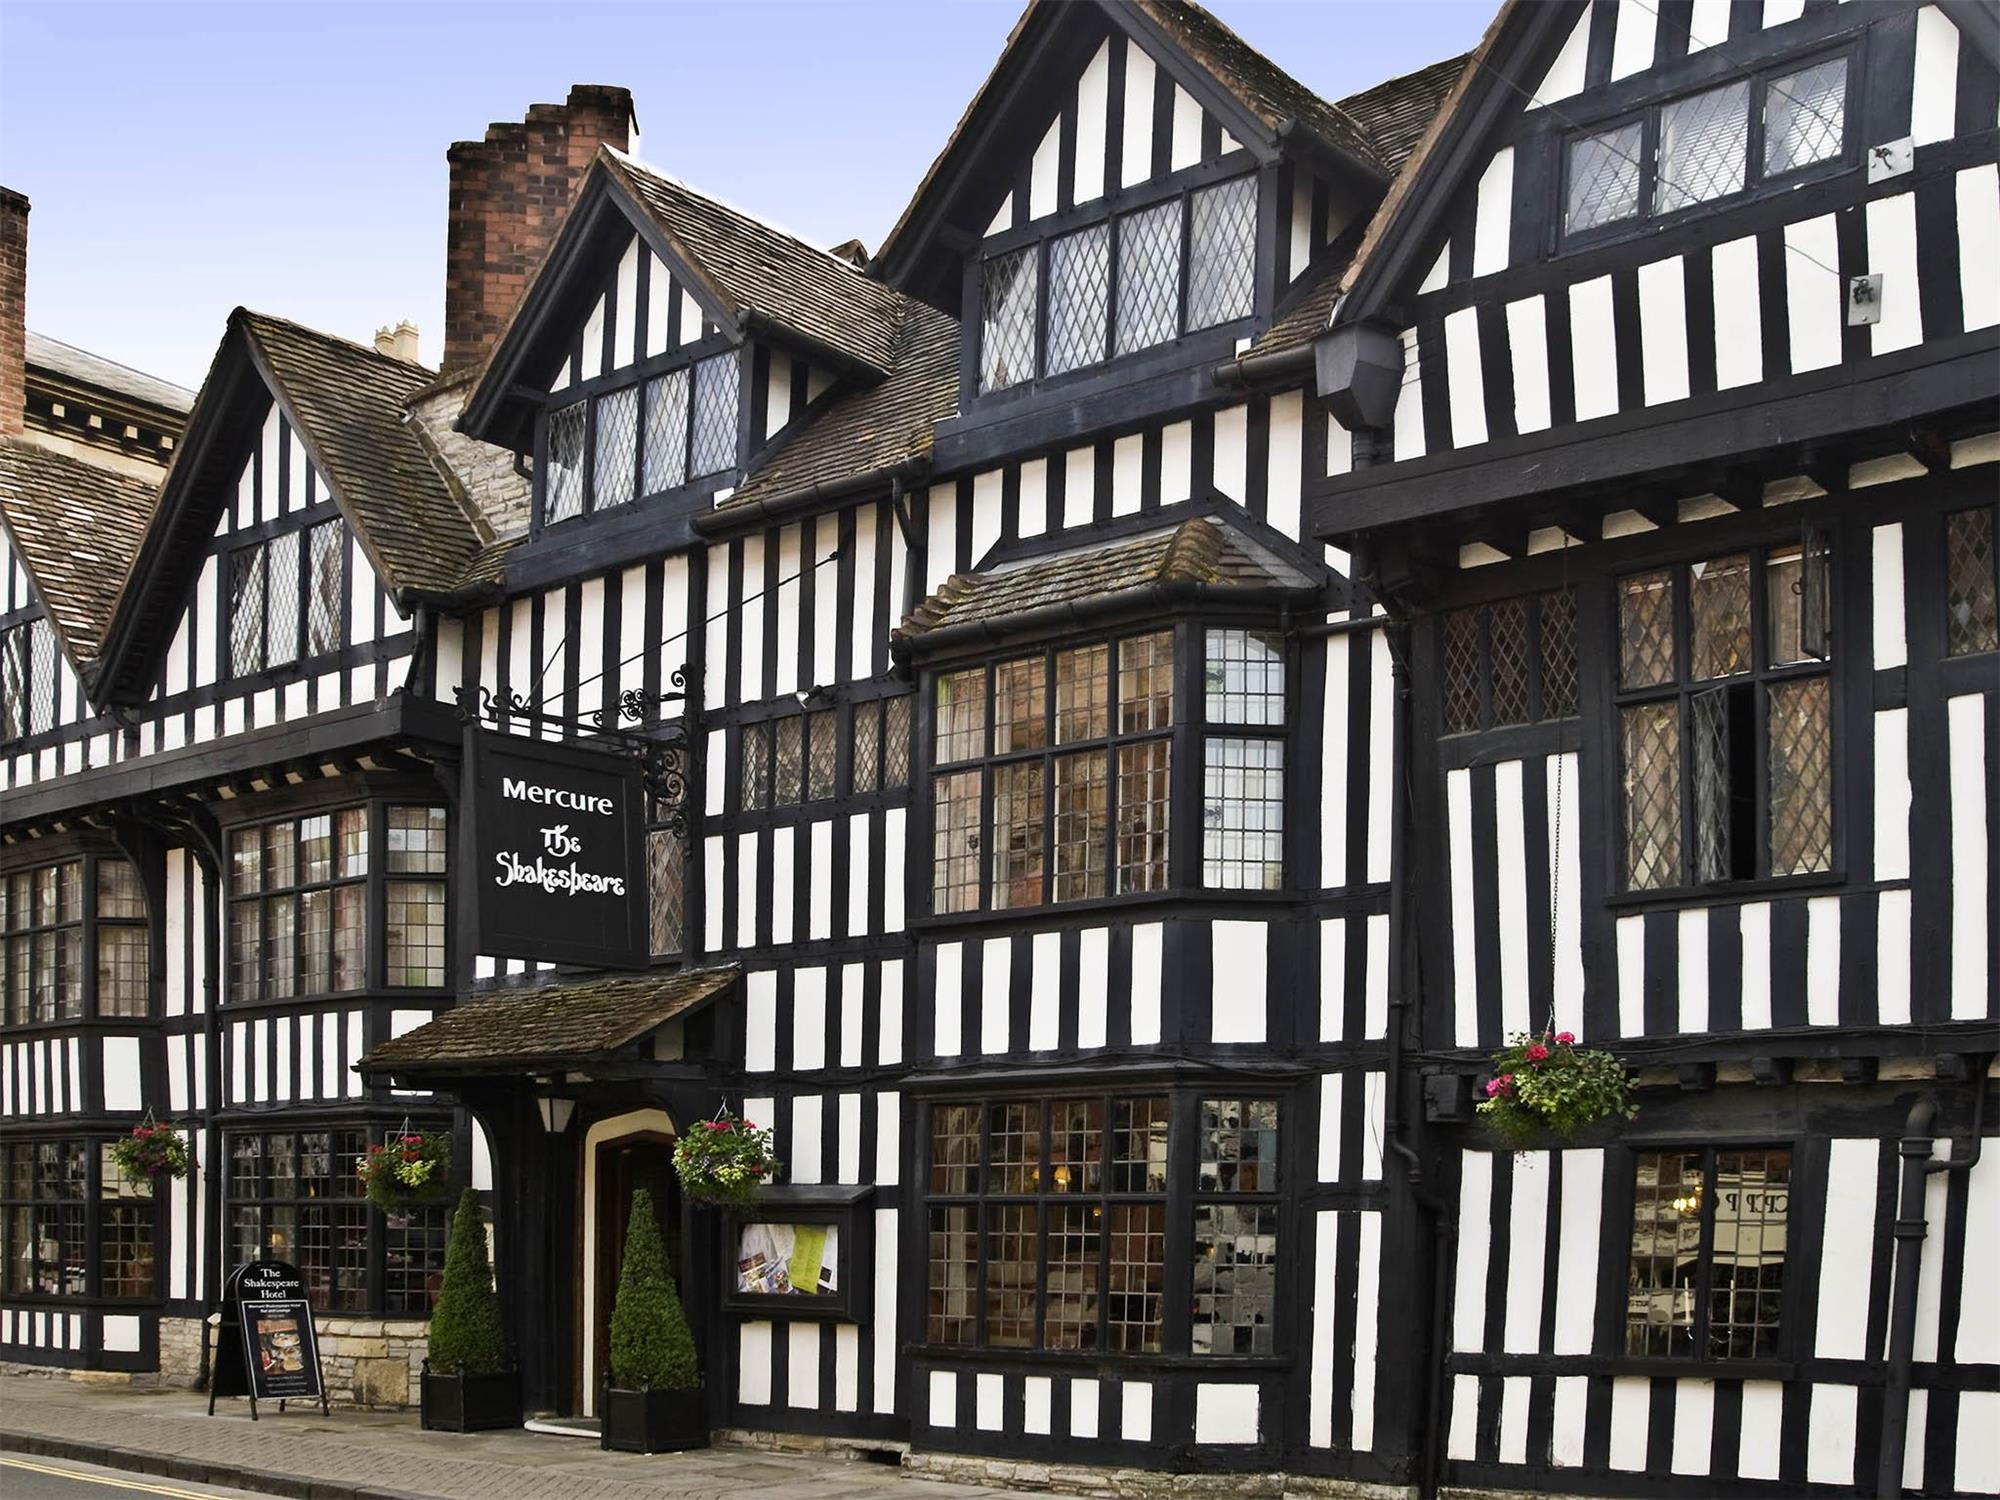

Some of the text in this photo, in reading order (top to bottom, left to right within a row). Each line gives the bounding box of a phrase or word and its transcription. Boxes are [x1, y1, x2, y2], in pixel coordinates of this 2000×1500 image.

[502, 777, 614, 815] Mercure
[539, 824, 582, 857] The
[495, 850, 626, 897] Shakespeare
[244, 1278, 300, 1290] Shakespeare
[260, 1268, 281, 1278] The
[260, 1289, 287, 1299] Hotel
